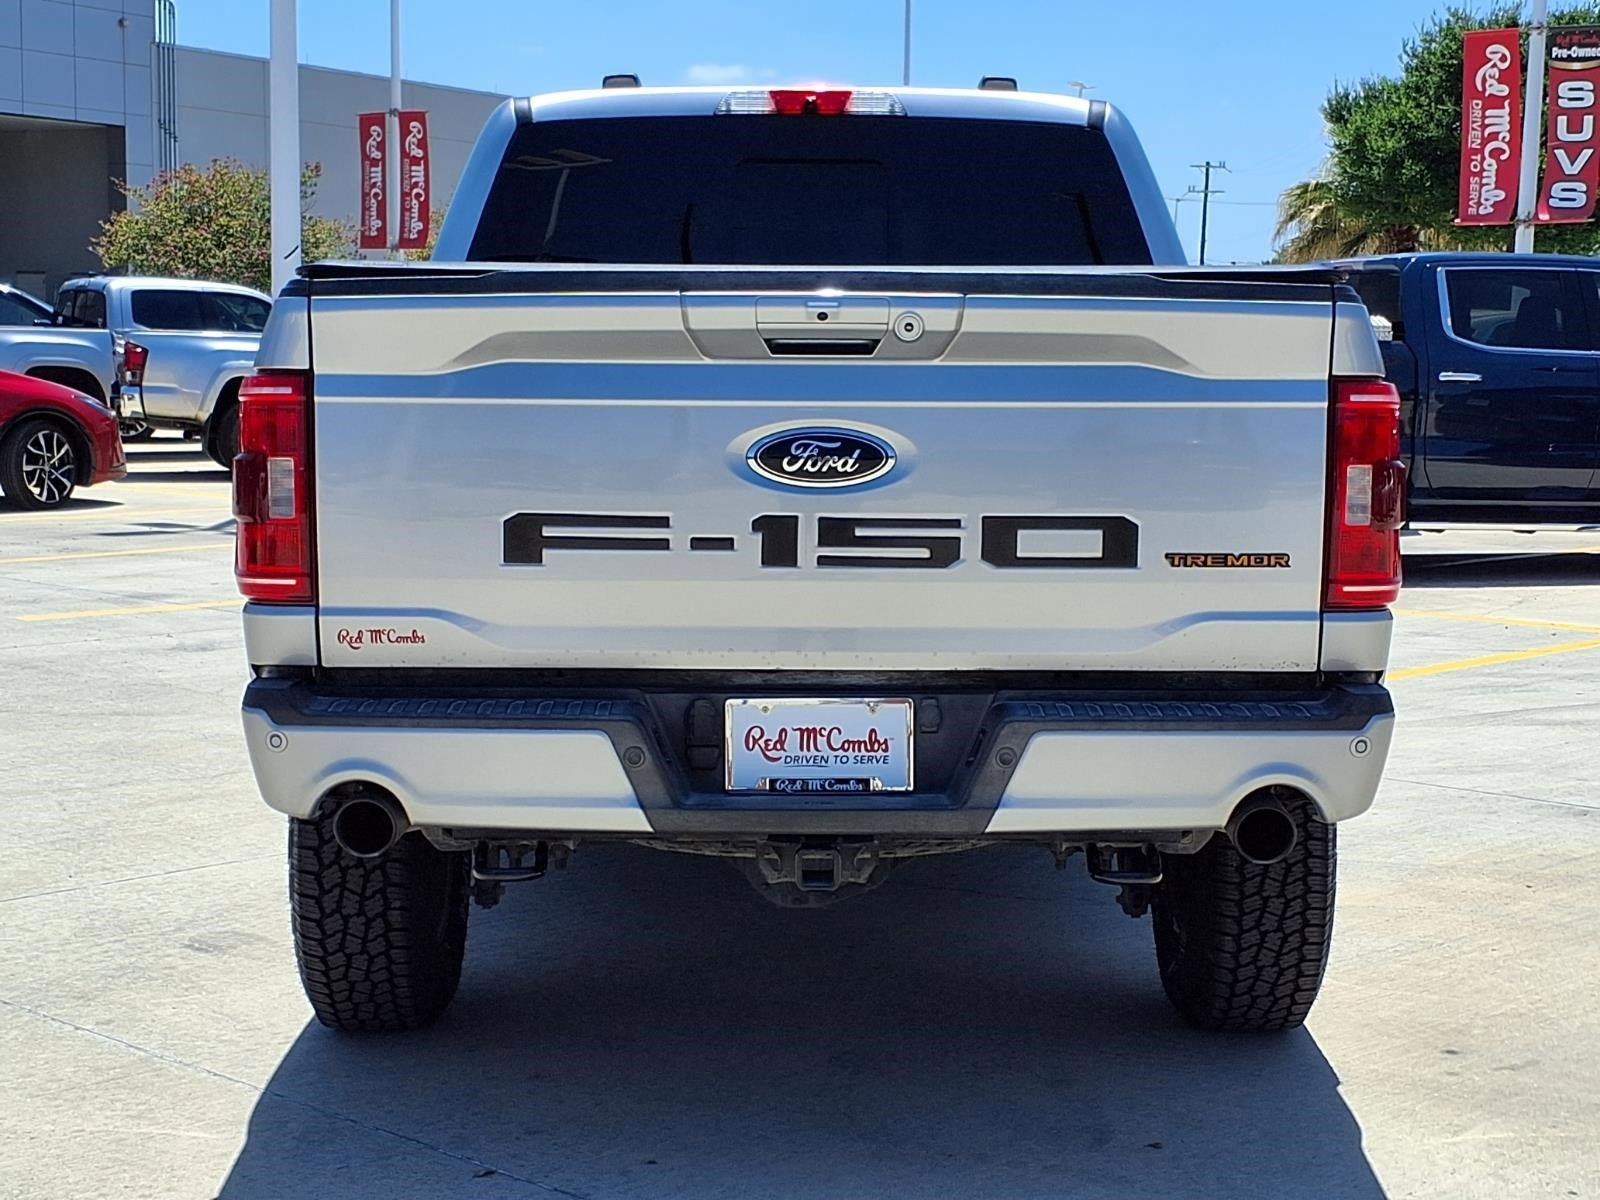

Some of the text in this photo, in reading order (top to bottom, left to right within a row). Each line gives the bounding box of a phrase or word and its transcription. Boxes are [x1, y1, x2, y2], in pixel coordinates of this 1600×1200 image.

[1475, 43, 1511, 216] Red McCombs
[1548, 80, 1595, 209] SUVS
[366, 125, 383, 237] Red McCombs
[405, 121, 425, 239] Red McCombs
[1468, 99, 1482, 216] DRIVEN TO SERVE
[782, 439, 862, 473] Ford
[499, 511, 1140, 570] F-150
[1164, 552, 1292, 568] TREMOR
[337, 628, 426, 650] Red McCombs
[744, 725, 890, 762] Red McCombs
[784, 754, 890, 765] DRIVEN TO SERVE
[776, 779, 863, 793] Red McCombs
